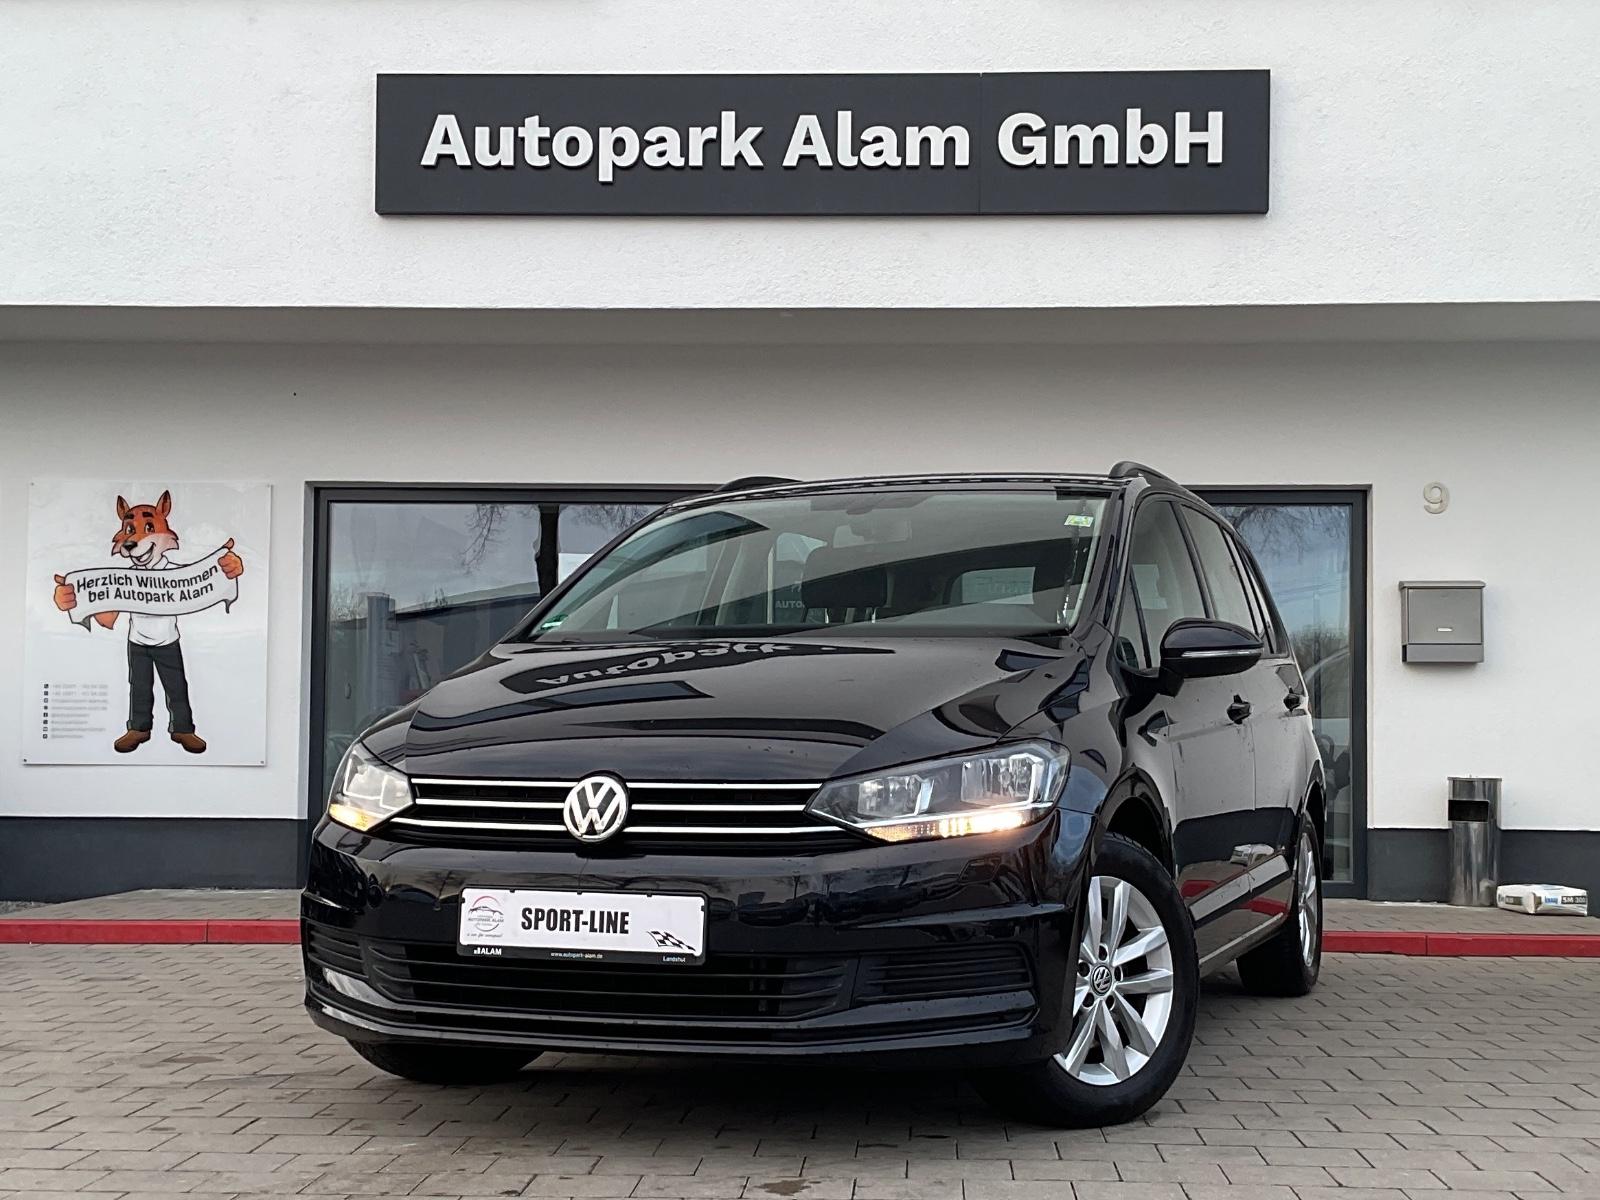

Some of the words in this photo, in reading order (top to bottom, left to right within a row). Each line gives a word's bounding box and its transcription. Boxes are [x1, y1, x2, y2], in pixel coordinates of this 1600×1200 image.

[420, 110, 764, 184] Autopark
[782, 110, 970, 168] Alam
[997, 108, 1224, 166] GmbH
[1423, 481, 1450, 515] 9
[77, 573, 133, 593] Herzlich
[136, 565, 218, 589] Willkommen
[88, 587, 110, 603] bei
[114, 588, 175, 604] Autopark
[179, 583, 214, 602] Alam
[775, 600, 805, 609] AUTO
[564, 776, 627, 842] VW
[521, 907, 630, 935] SPORT-LINE
[480, 947, 502, 956] ALAM
